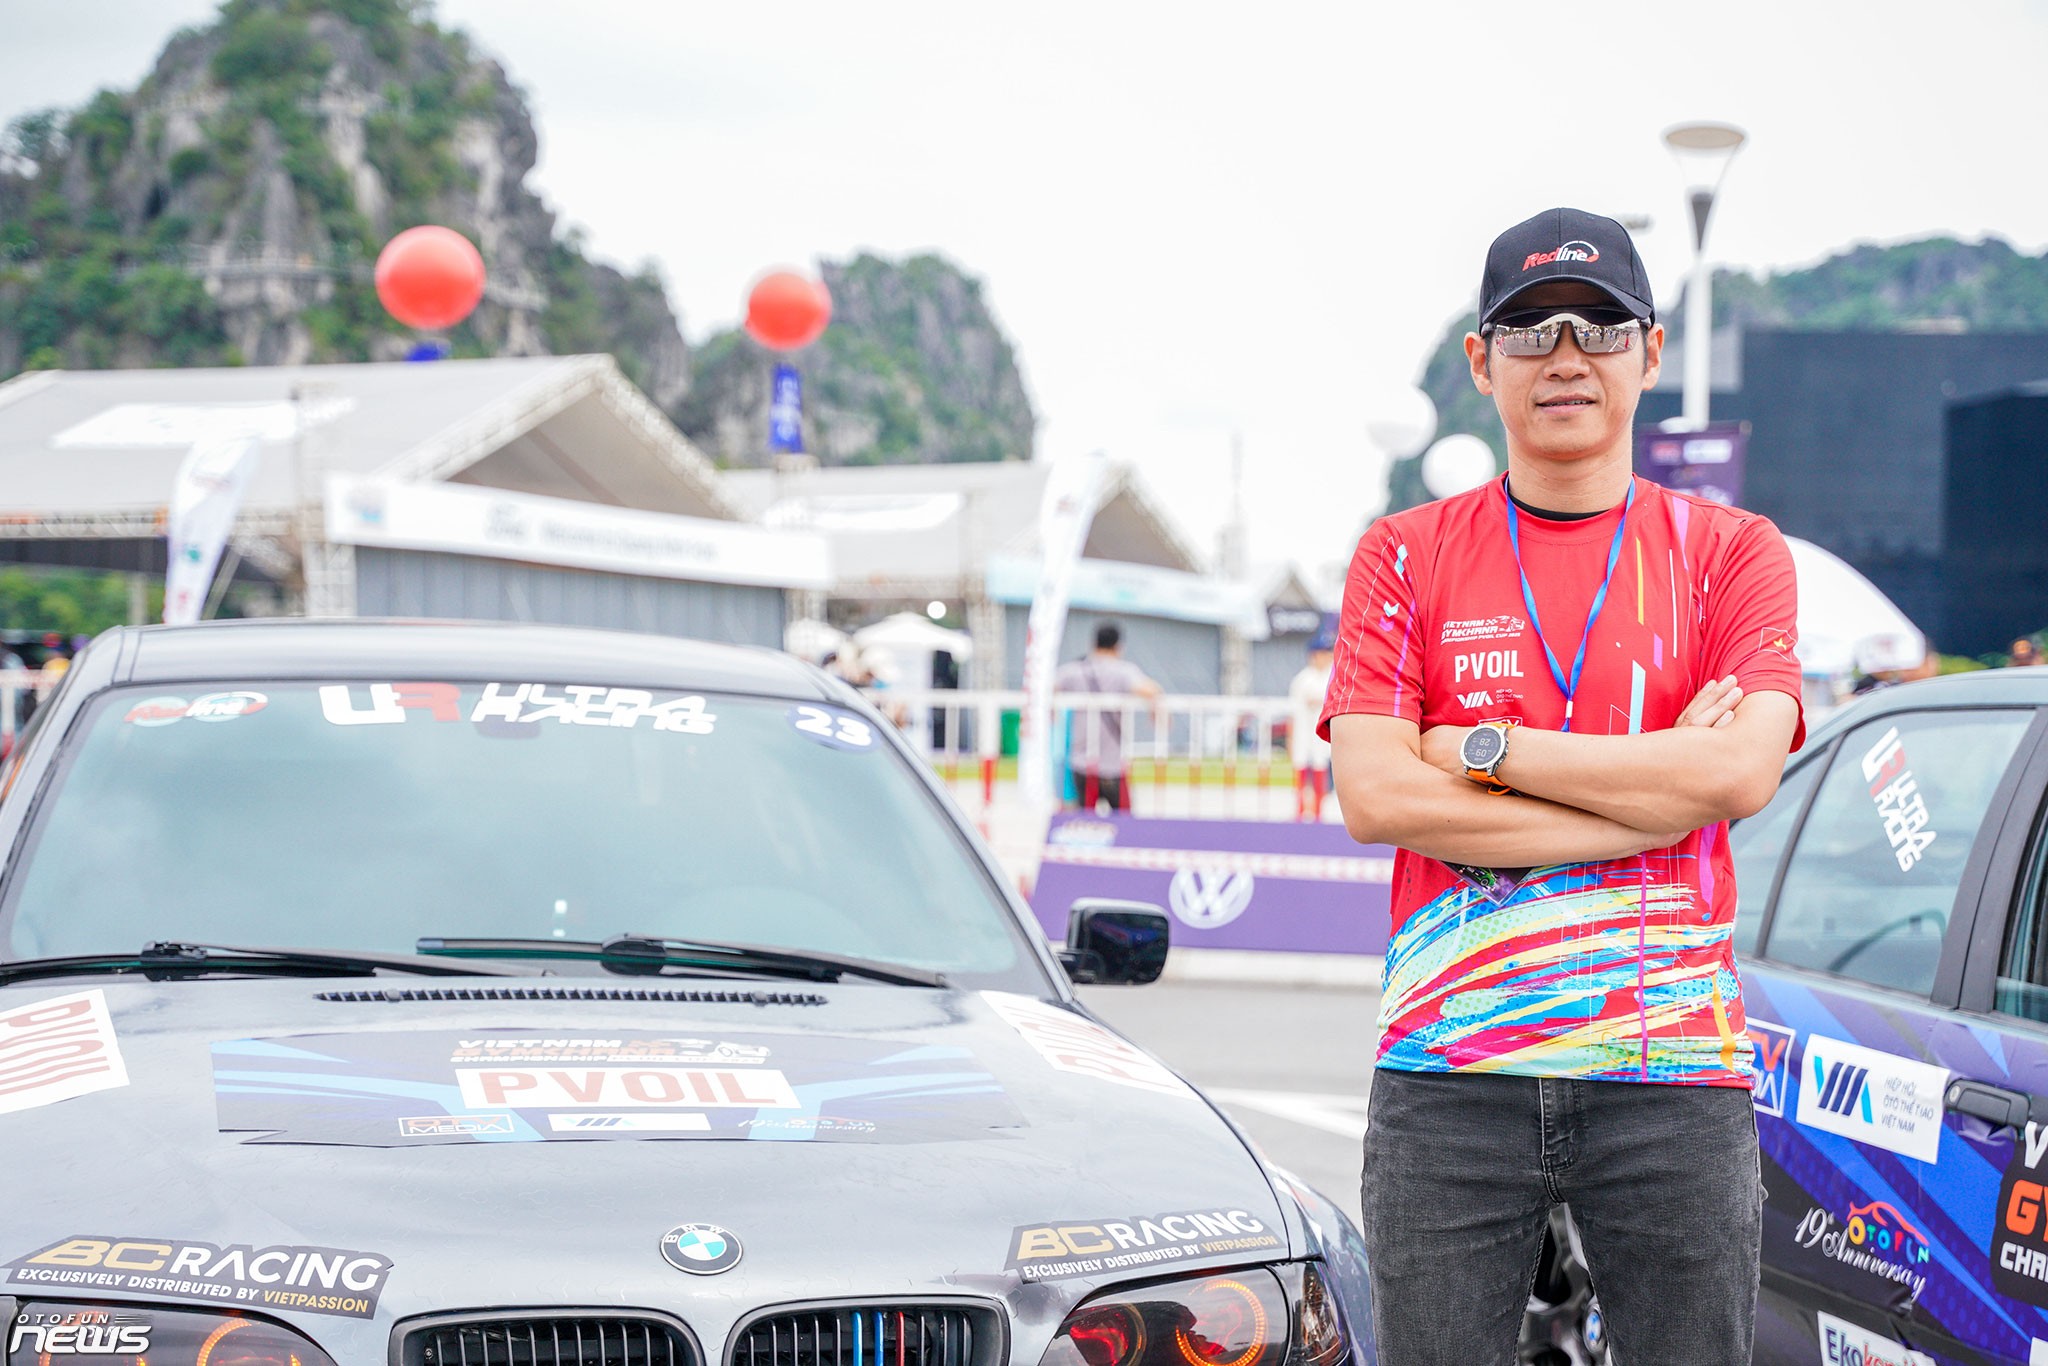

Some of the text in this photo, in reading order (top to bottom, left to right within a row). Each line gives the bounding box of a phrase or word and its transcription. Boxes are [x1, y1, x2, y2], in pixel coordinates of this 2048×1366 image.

[1522, 245, 1589, 271] Redline
[1454, 650, 1524, 683] PVOIL
[795, 705, 872, 747] 23
[458, 1039, 622, 1048] VIETNAM
[478, 1071, 778, 1104] PVOIL
[409, 1123, 506, 1134] MEDIA
[1897, 1118, 1916, 1133] NAM
[664, 1223, 725, 1243] BMW
[1022, 1235, 1278, 1278] EXCLUSIVELY DISTRIBUTED BY VIETPASSION
[1822, 1228, 1927, 1303] Anniversary
[16, 1268, 368, 1313] EXCLUSIVELY DISTRIBUTED BY VIETPASSION
